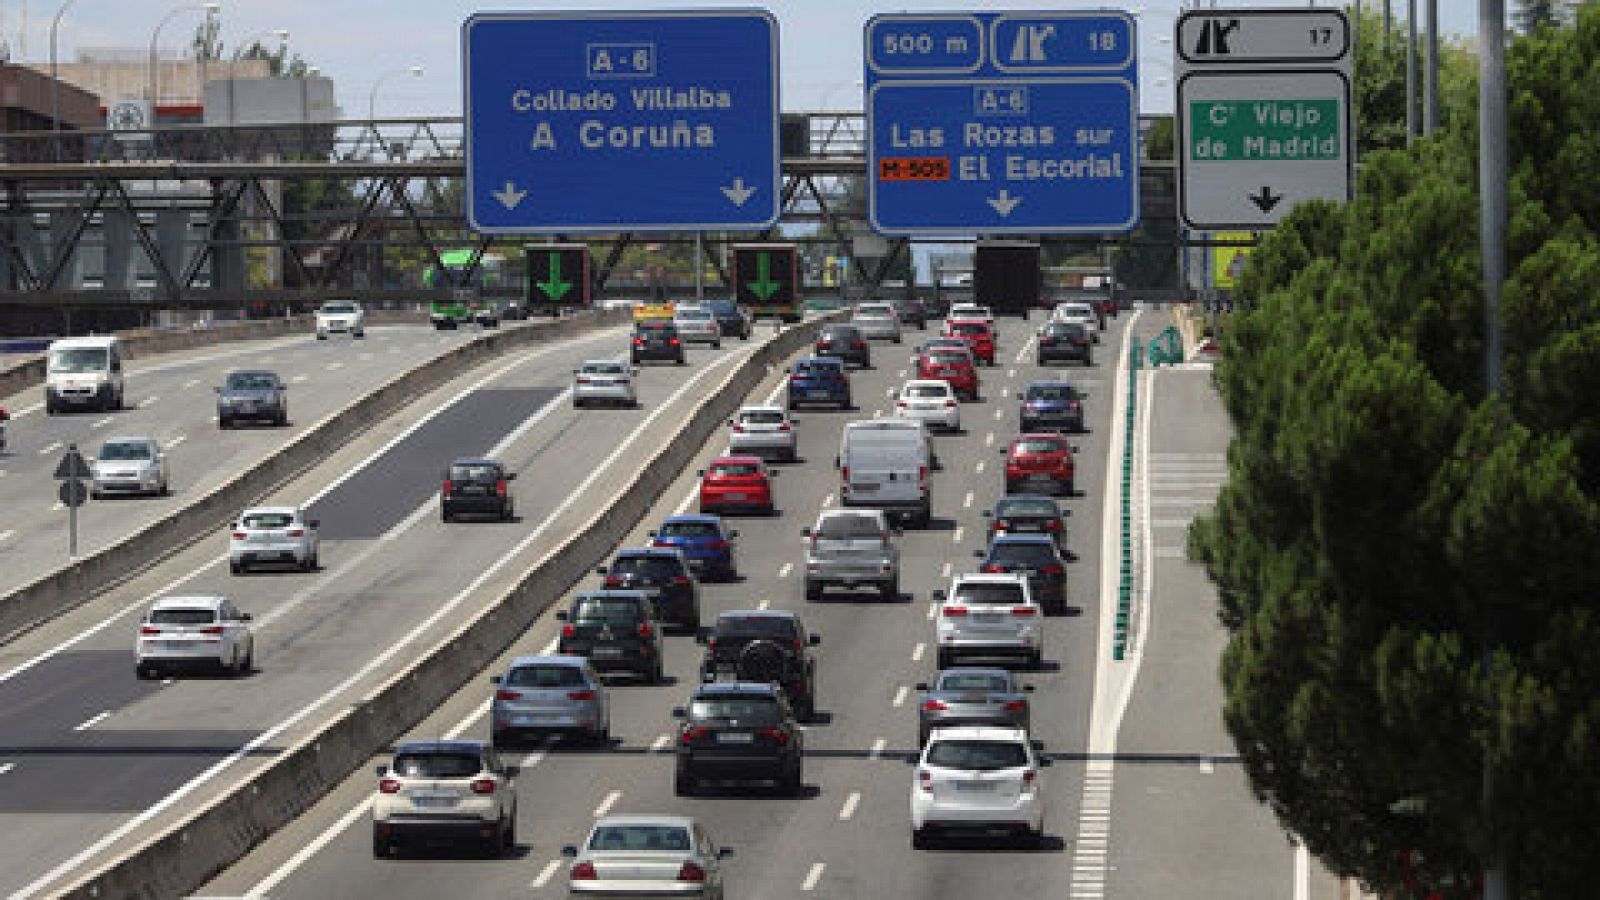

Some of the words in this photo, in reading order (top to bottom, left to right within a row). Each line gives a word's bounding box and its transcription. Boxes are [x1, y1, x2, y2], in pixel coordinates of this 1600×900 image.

[884, 34, 933, 53] 500
[946, 37, 967, 53] m
[1088, 31, 1117, 51] 18
[1309, 29, 1332, 45] 17
[512, 89, 616, 111] Collado
[631, 87, 732, 111] Villalba
[1253, 103, 1321, 128] Viejo
[532, 123, 555, 150] A
[580, 119, 714, 149] Coruña
[891, 123, 944, 147] Las
[965, 123, 1054, 147] Rozas
[1075, 128, 1114, 145] sur
[1195, 136, 1228, 158] de
[1243, 134, 1335, 157] Madrid
[959, 156, 990, 180] El
[1006, 153, 1123, 181] Escorial
